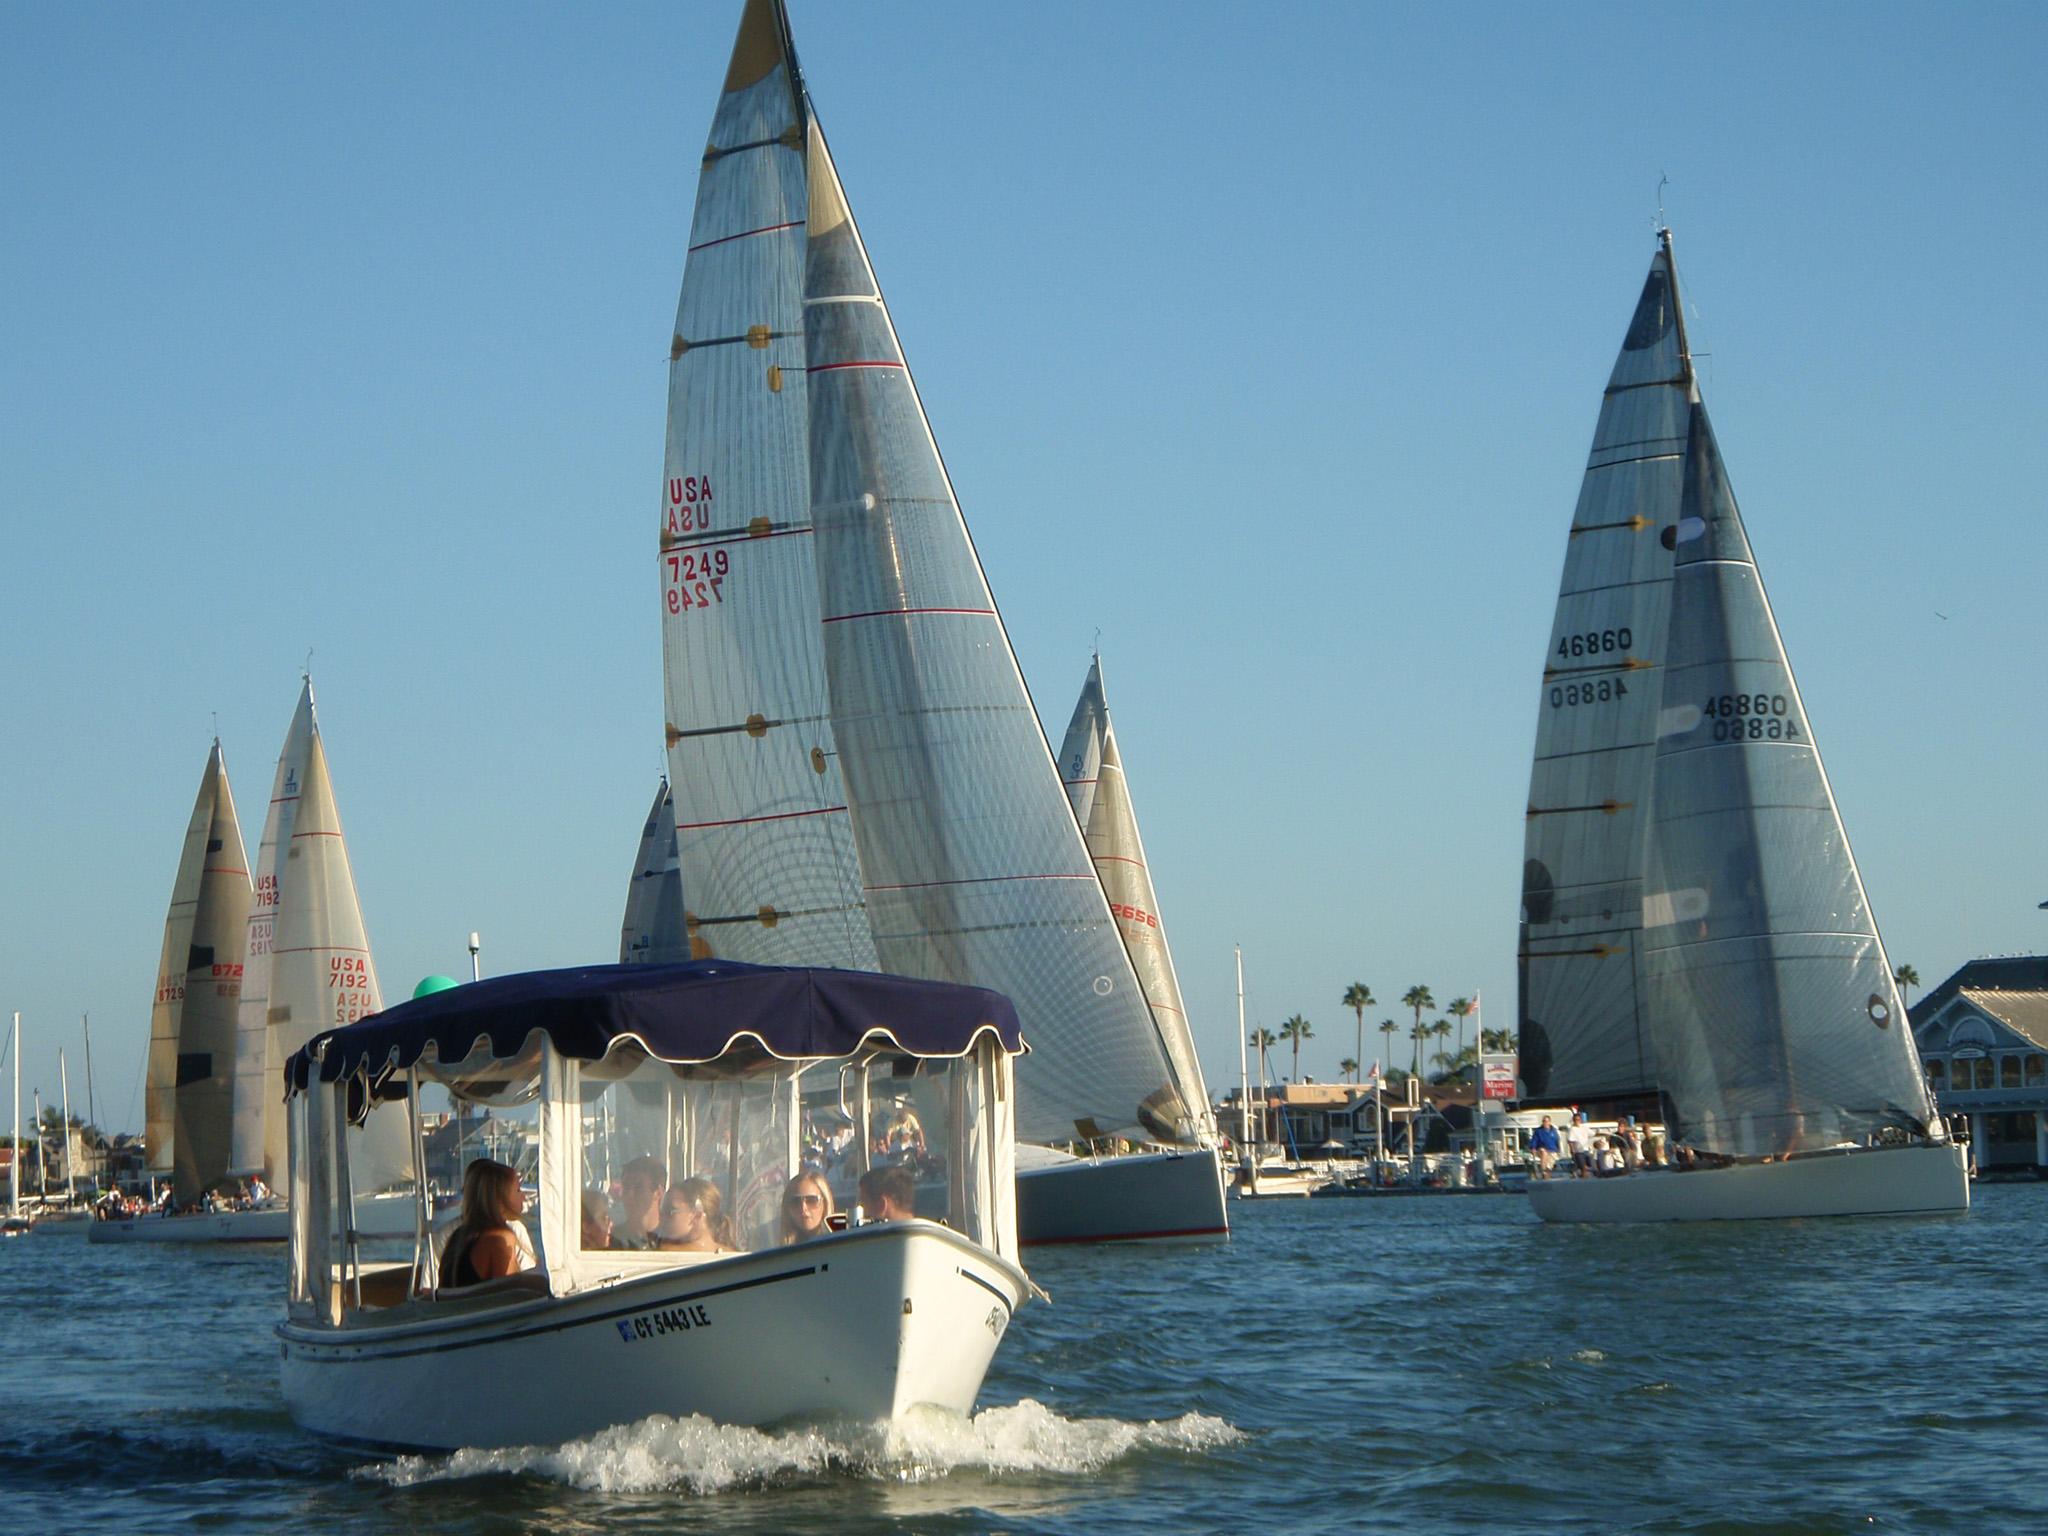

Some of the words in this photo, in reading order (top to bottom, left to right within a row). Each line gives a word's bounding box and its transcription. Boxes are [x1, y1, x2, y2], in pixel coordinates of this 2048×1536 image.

[670, 475, 712, 504] USA
[667, 550, 729, 583] 7249
[1557, 628, 1632, 658] 46860
[1704, 694, 1787, 719] 46860
[258, 874, 278, 890] USA
[256, 891, 280, 907] 7192
[331, 957, 365, 973] USA
[329, 972, 368, 989] 7192
[634, 1317, 654, 1338] CF
[653, 1309, 690, 1335] 5443
